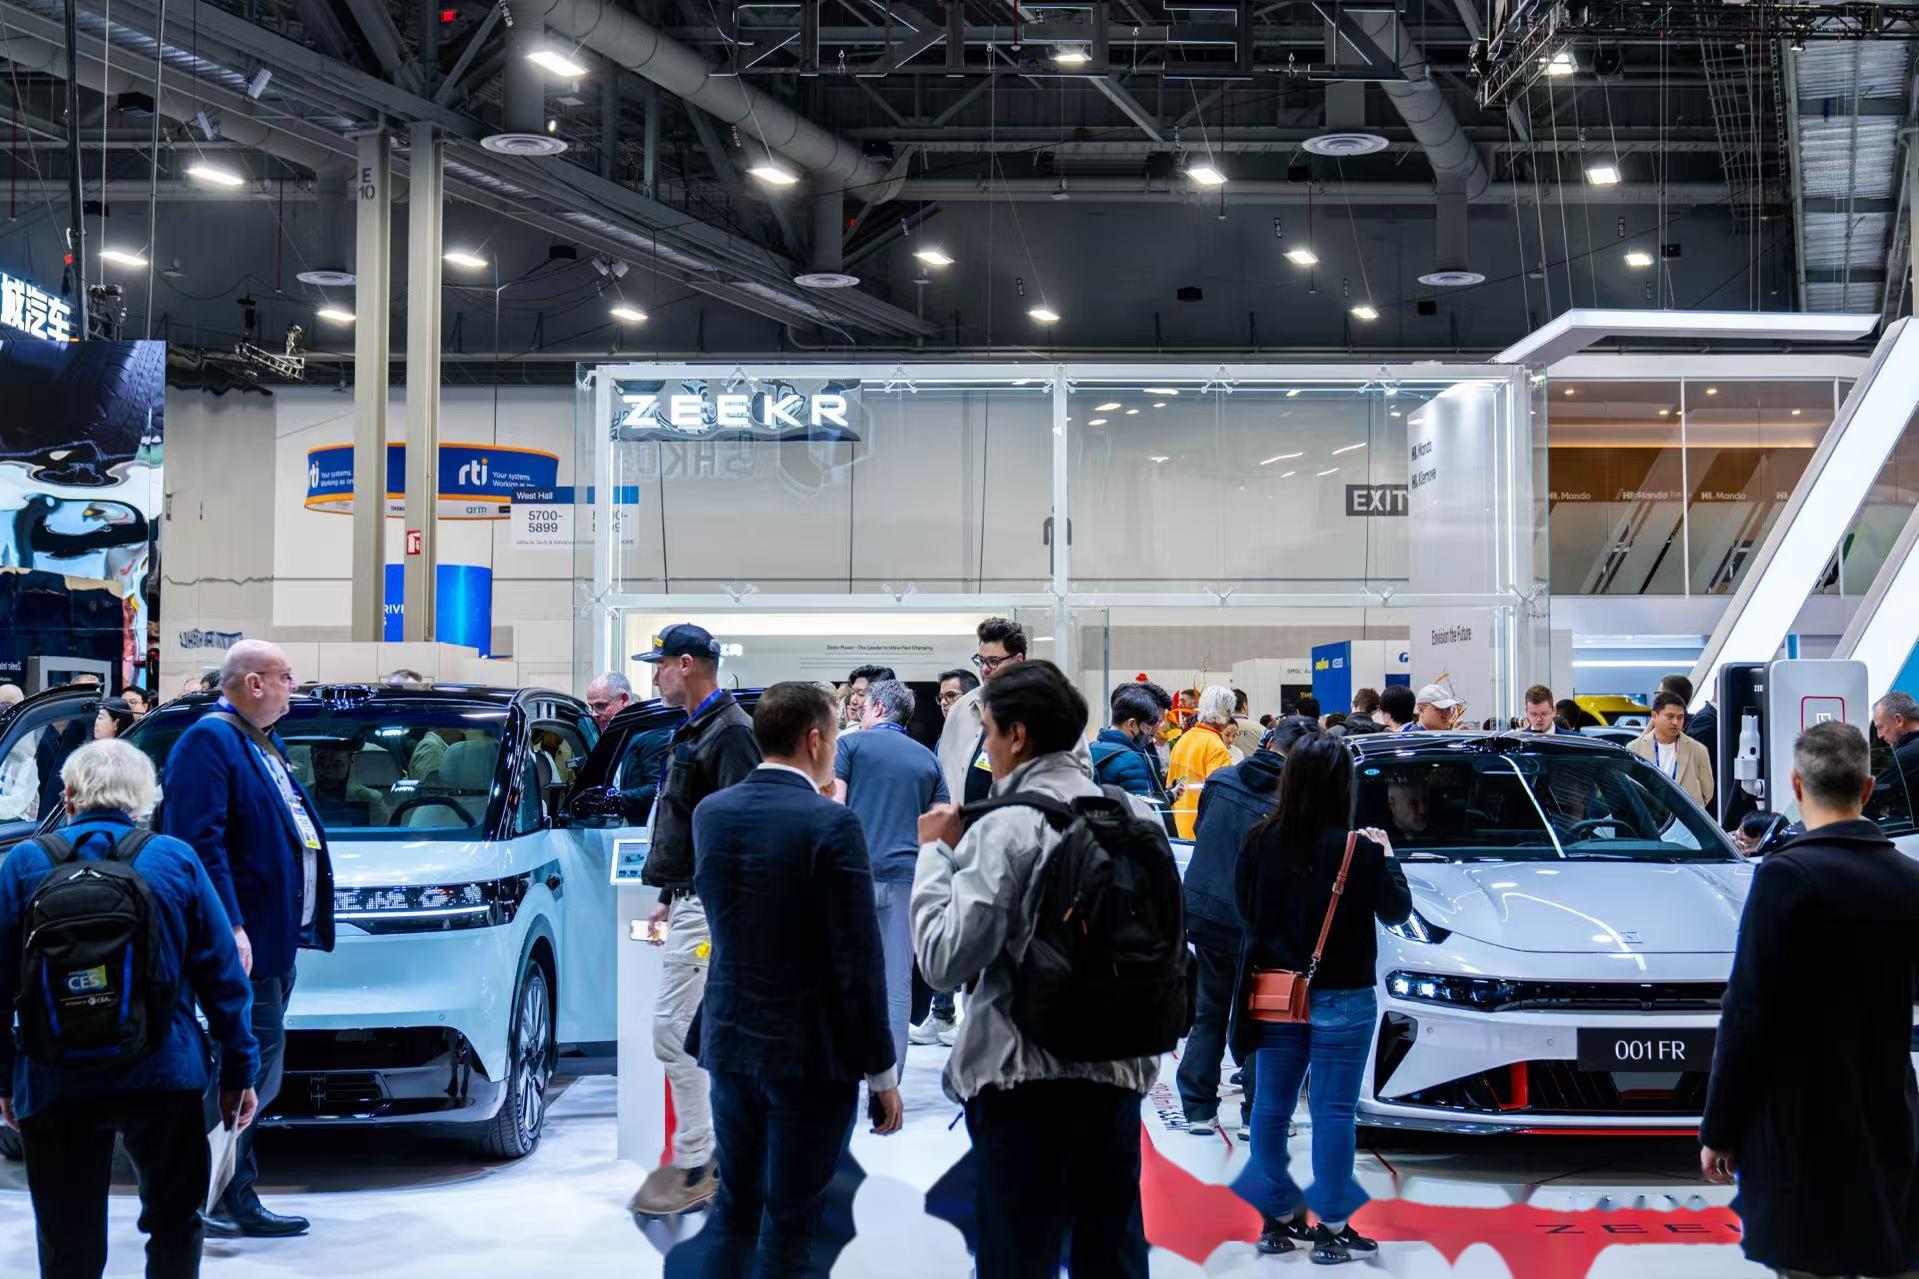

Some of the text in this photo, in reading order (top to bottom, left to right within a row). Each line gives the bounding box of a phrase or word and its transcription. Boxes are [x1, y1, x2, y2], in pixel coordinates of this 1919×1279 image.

[362, 168, 372, 183] E
[622, 394, 849, 428] ZEEKR
[459, 456, 488, 486] rti
[516, 492, 553, 500] West Hall
[1353, 490, 1408, 511] EXIT
[466, 505, 487, 514] arm
[528, 510, 563, 521] 5700-
[528, 522, 558, 533] 5899
[1457, 624, 1472, 641] Future
[68, 976, 100, 990] CES
[1535, 1223, 1742, 1234] ZEE
